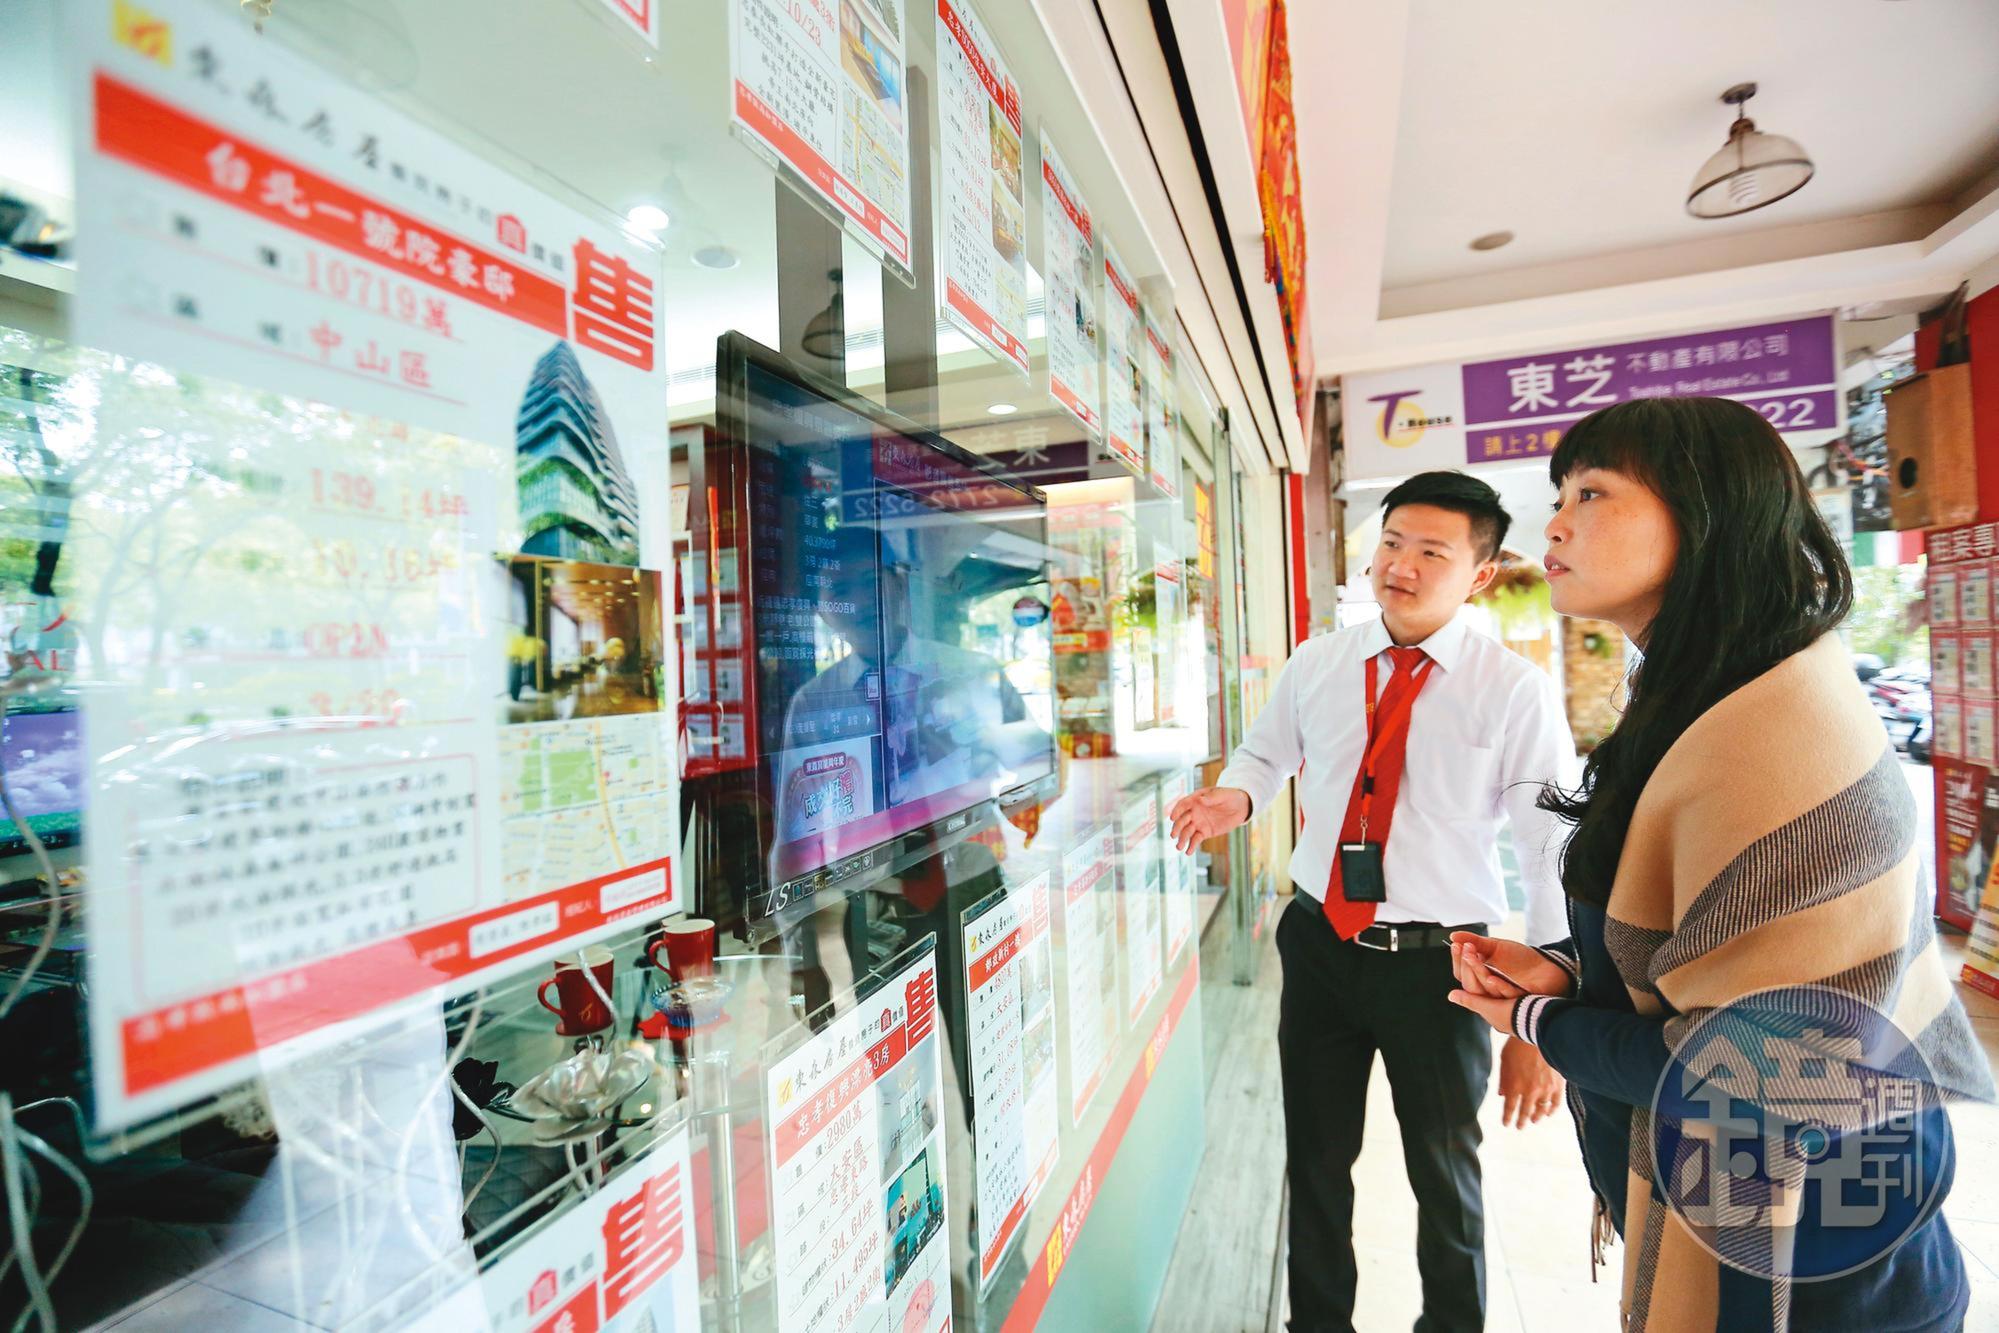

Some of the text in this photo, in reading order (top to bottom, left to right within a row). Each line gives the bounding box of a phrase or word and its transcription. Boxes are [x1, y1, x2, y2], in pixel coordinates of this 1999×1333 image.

[204, 142, 516, 304] 台北一號院豪邸
[305, 250, 454, 338] 10719萬
[572, 237, 654, 372] 售
[308, 321, 432, 389] 中山區
[1507, 353, 1618, 412] 東芝
[1626, 334, 1789, 374] 不動產有限公司
[905, 967, 936, 1052] 售
[827, 1099, 862, 1150] 2980萬
[602, 1161, 684, 1322] 售
